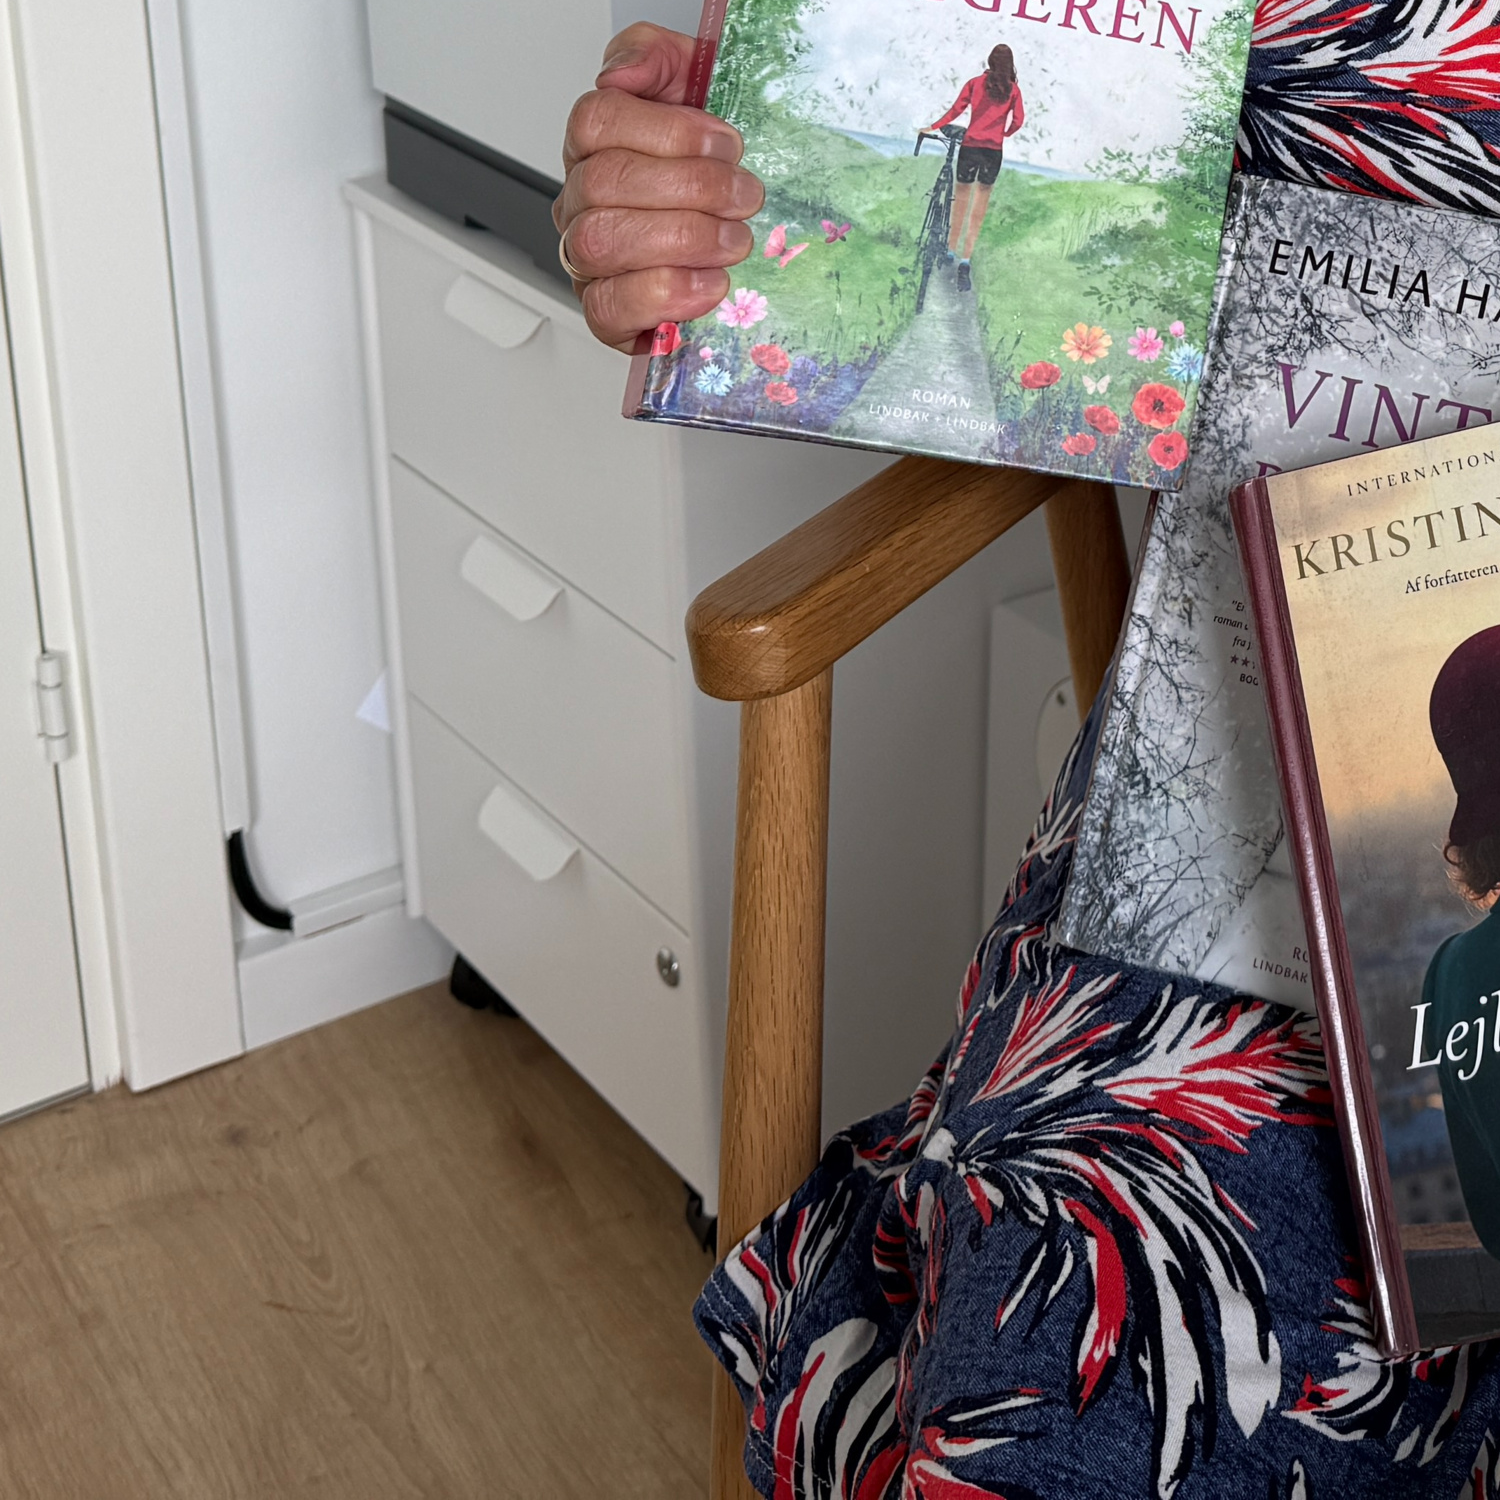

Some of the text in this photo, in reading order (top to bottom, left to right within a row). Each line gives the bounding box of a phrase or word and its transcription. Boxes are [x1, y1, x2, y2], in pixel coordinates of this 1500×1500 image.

[1267, 238, 1431, 308] EMILIA
[912, 389, 971, 409] ROMAN
[868, 404, 930, 422] LINDBAK
[946, 414, 1005, 434] LINDBAK
[1405, 577, 1421, 594] Af
[1424, 564, 1499, 588] forfatteren
[1213, 615, 1242, 629] roman
[1232, 636, 1246, 647] fra
[1253, 957, 1308, 984] LINDBAK
